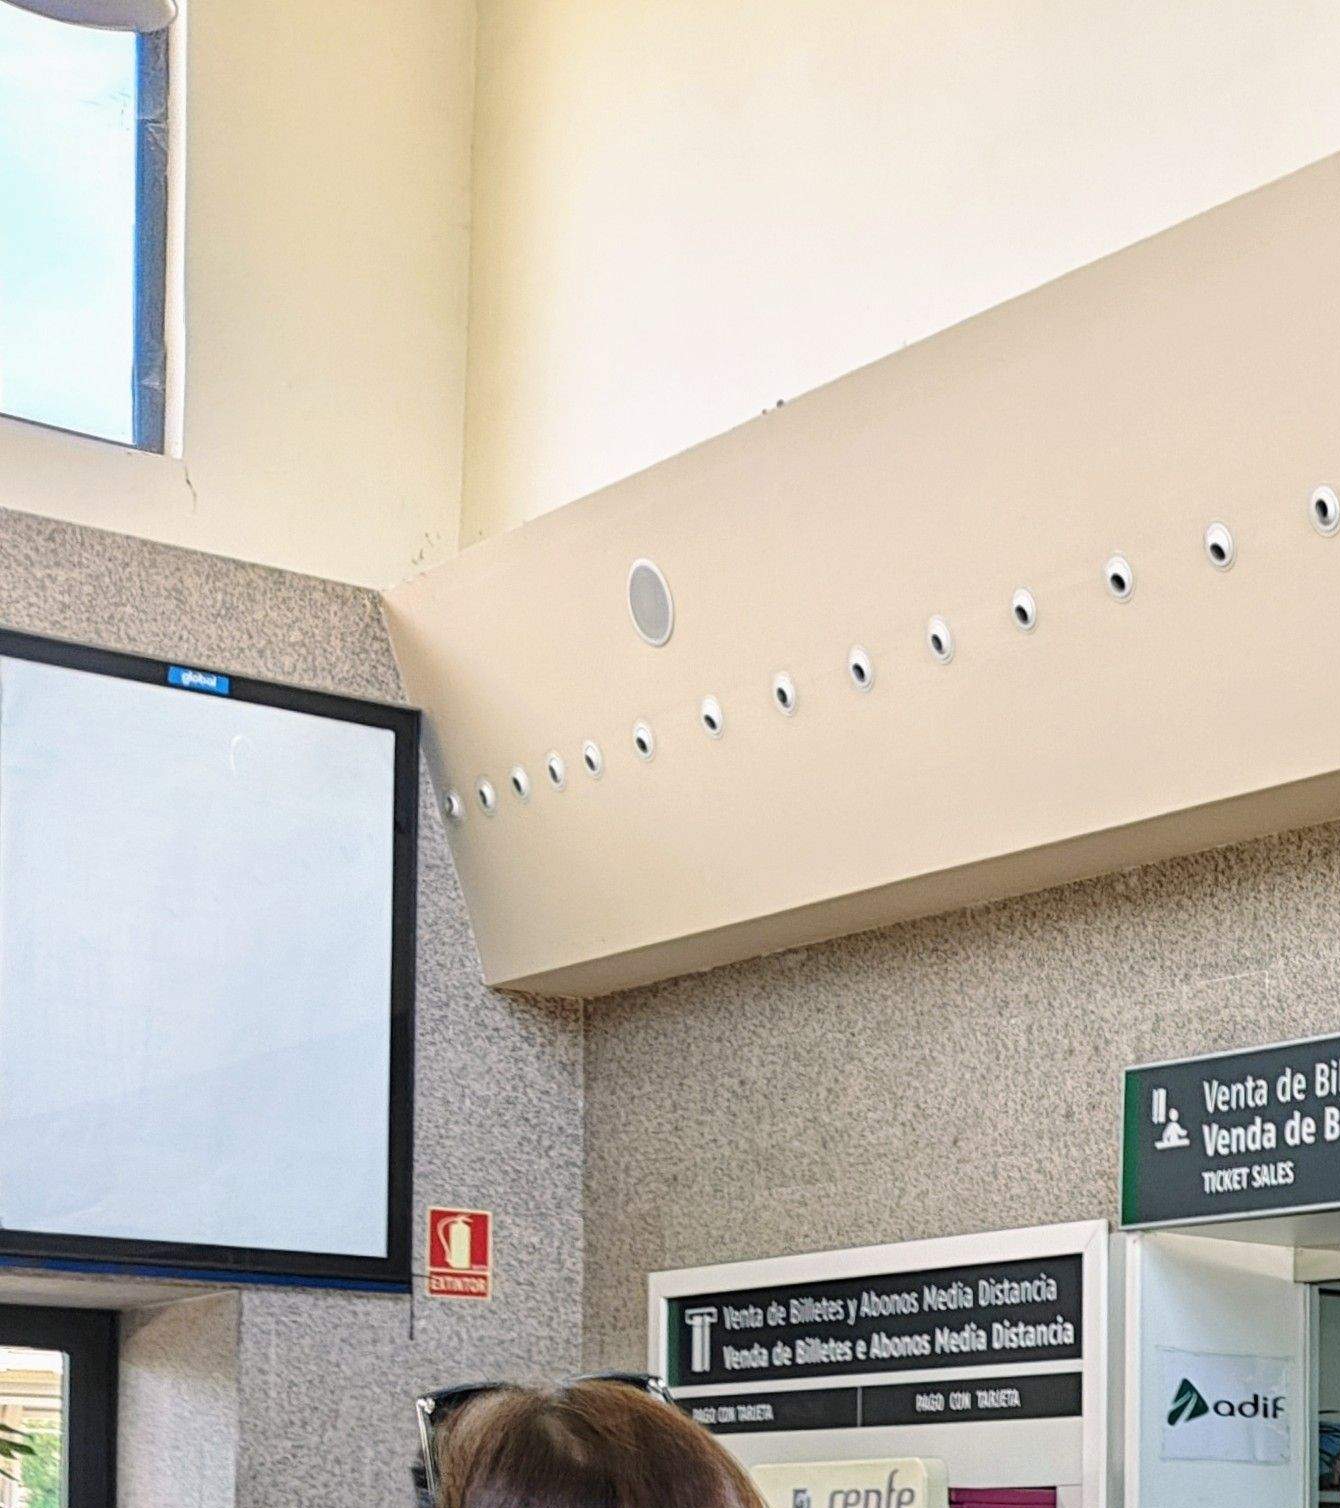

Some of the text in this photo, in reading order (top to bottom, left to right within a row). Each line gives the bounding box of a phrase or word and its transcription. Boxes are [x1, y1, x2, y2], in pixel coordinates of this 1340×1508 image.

[1203, 1075, 1268, 1114] Venta
[1276, 1067, 1306, 1102] de
[1202, 1116, 1276, 1157] Venda
[1284, 1110, 1316, 1147] de
[1202, 1161, 1294, 1194] TICKET SALES
[431, 1275, 487, 1293] EXTINTOR
[723, 1272, 1058, 1330] Venta de Billetes y Abonos Media Distancia
[722, 1314, 1074, 1370] Venda de Billetes e Abonos Media Distancia
[949, 1391, 972, 1411] CON
[1213, 1394, 1286, 1419] adif
